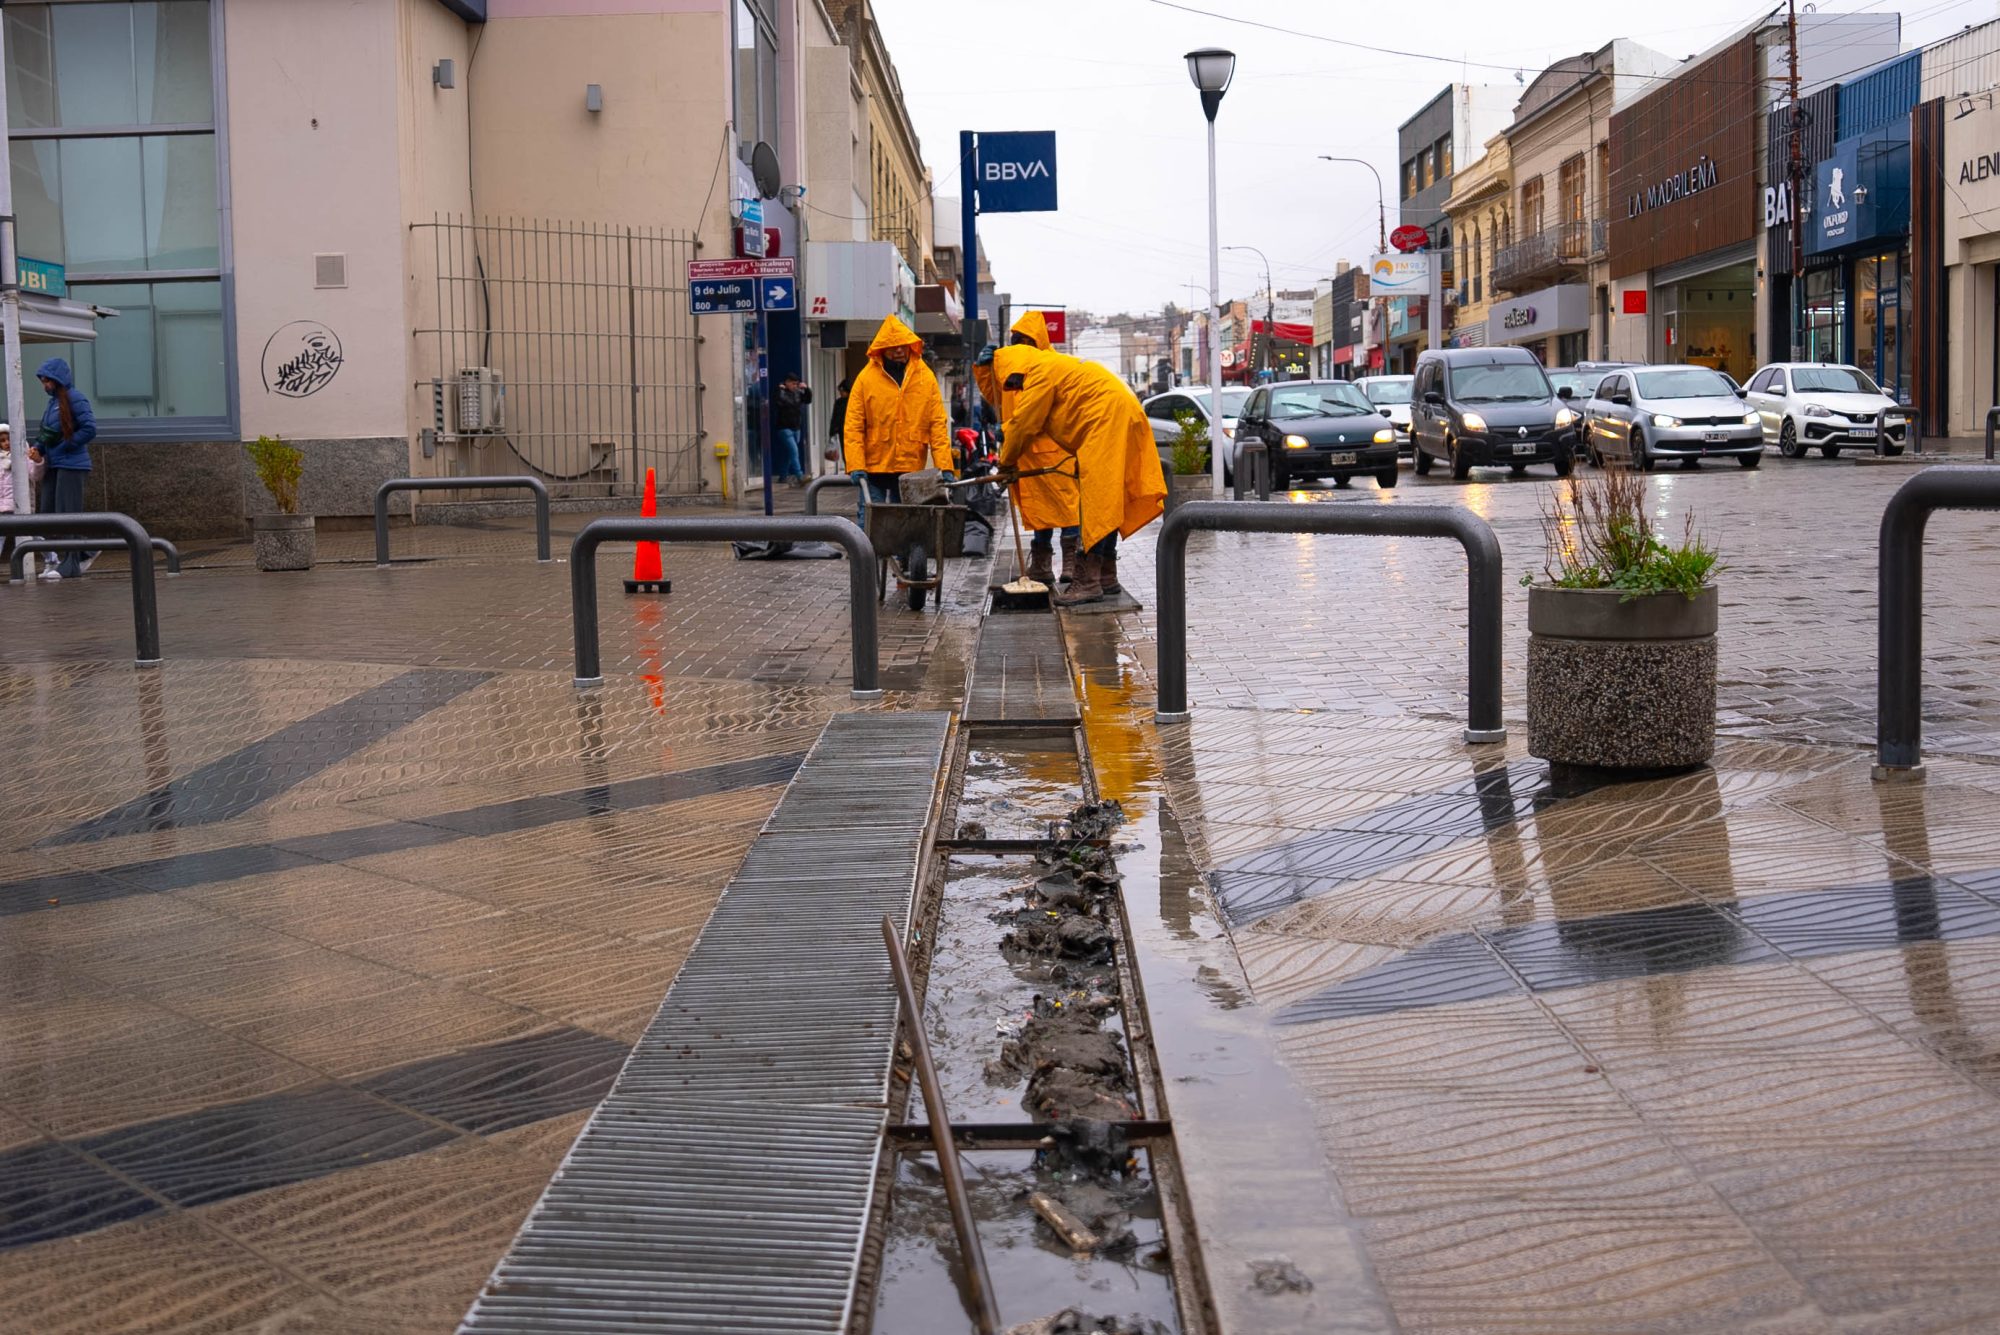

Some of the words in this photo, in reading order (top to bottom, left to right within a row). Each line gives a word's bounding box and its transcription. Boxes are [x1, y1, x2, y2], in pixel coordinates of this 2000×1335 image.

[985, 159, 1050, 180] BBVA
[1959, 151, 2000, 185] ALEN
[1628, 191, 1643, 218] LA
[1646, 155, 1717, 211] MADRILEÑA
[694, 286, 701, 296] 9
[702, 285, 715, 295] de
[717, 284, 741, 294] Julio
[695, 302, 711, 311] 800
[735, 300, 752, 308] 900
